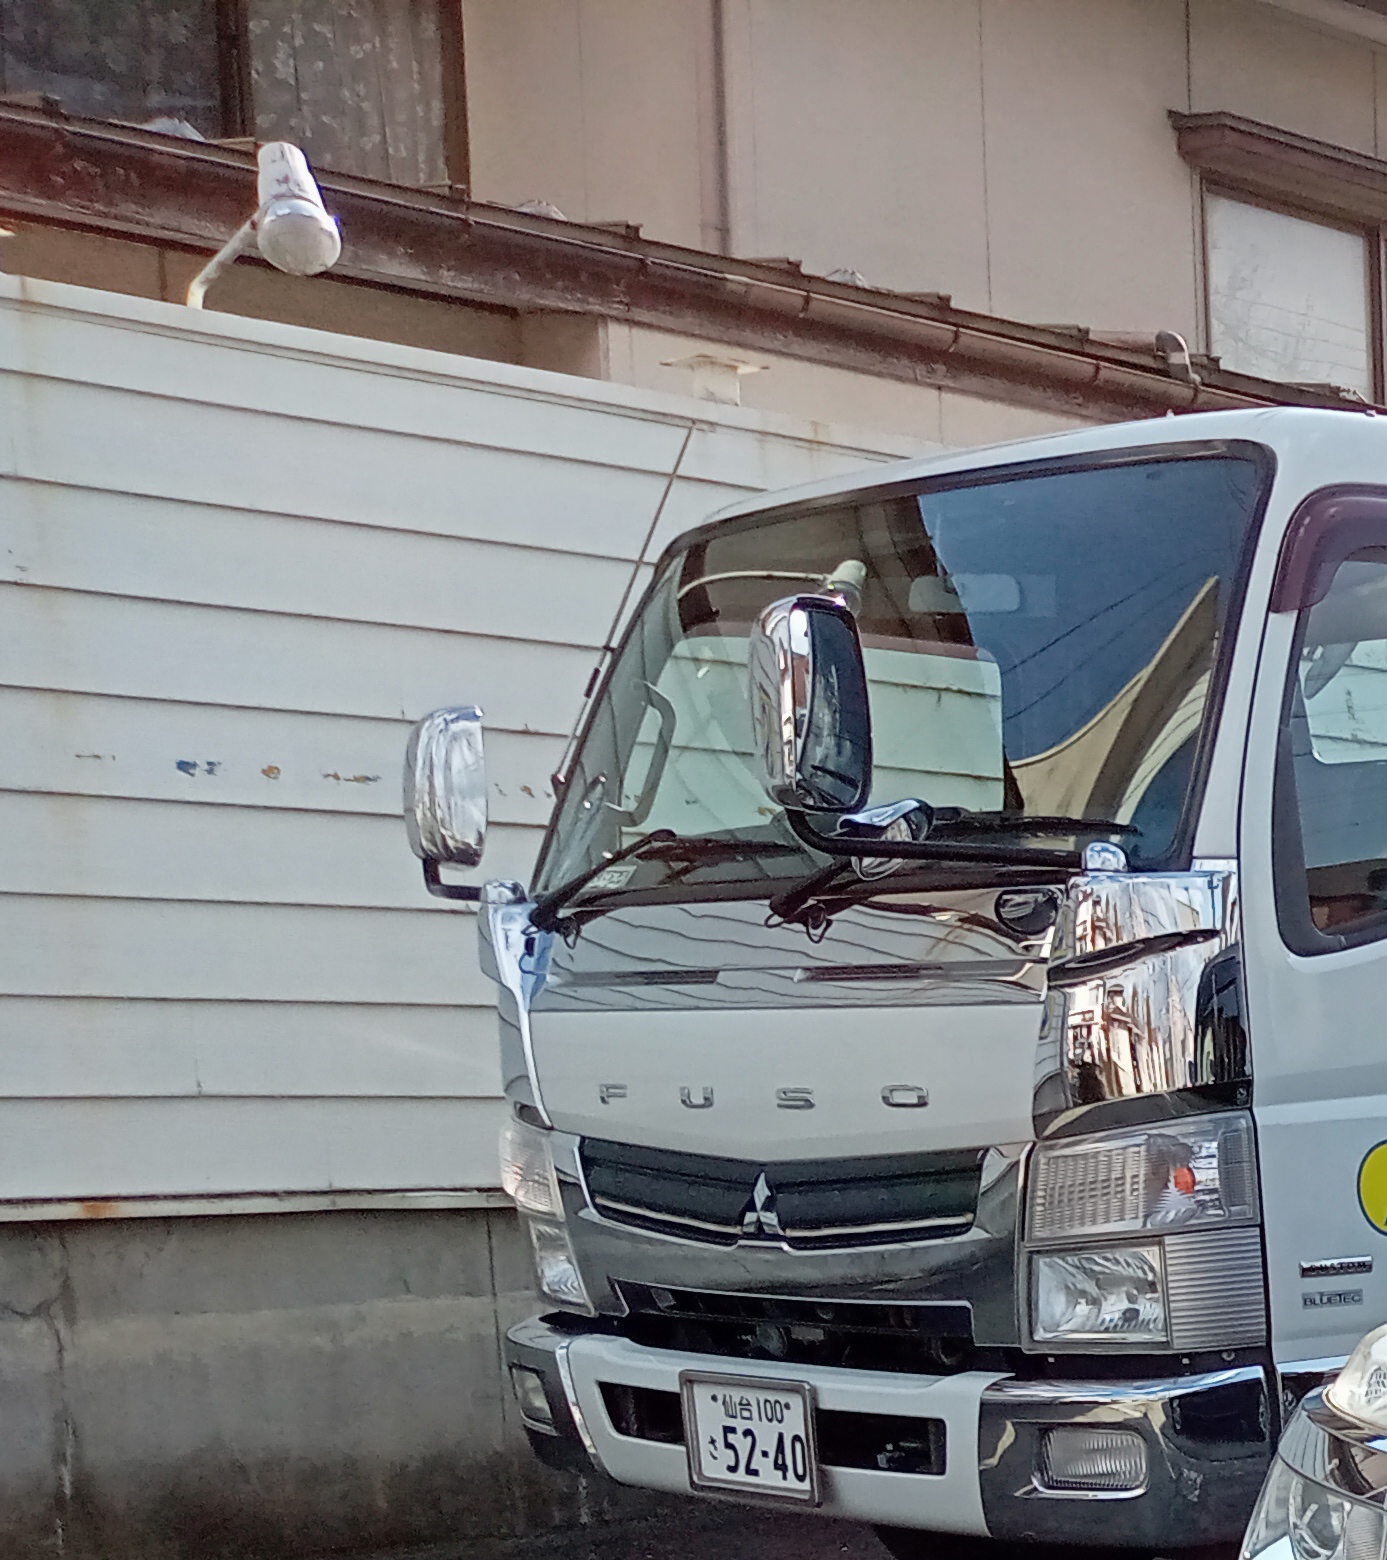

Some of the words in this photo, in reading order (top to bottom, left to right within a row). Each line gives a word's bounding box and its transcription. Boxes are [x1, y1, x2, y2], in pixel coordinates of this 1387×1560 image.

[598, 1083, 930, 1110] FUSO
[1309, 1261, 1368, 1275] CUSTOM
[708, 1435, 719, 1460] さ
[721, 1424, 808, 1483] 52-40
